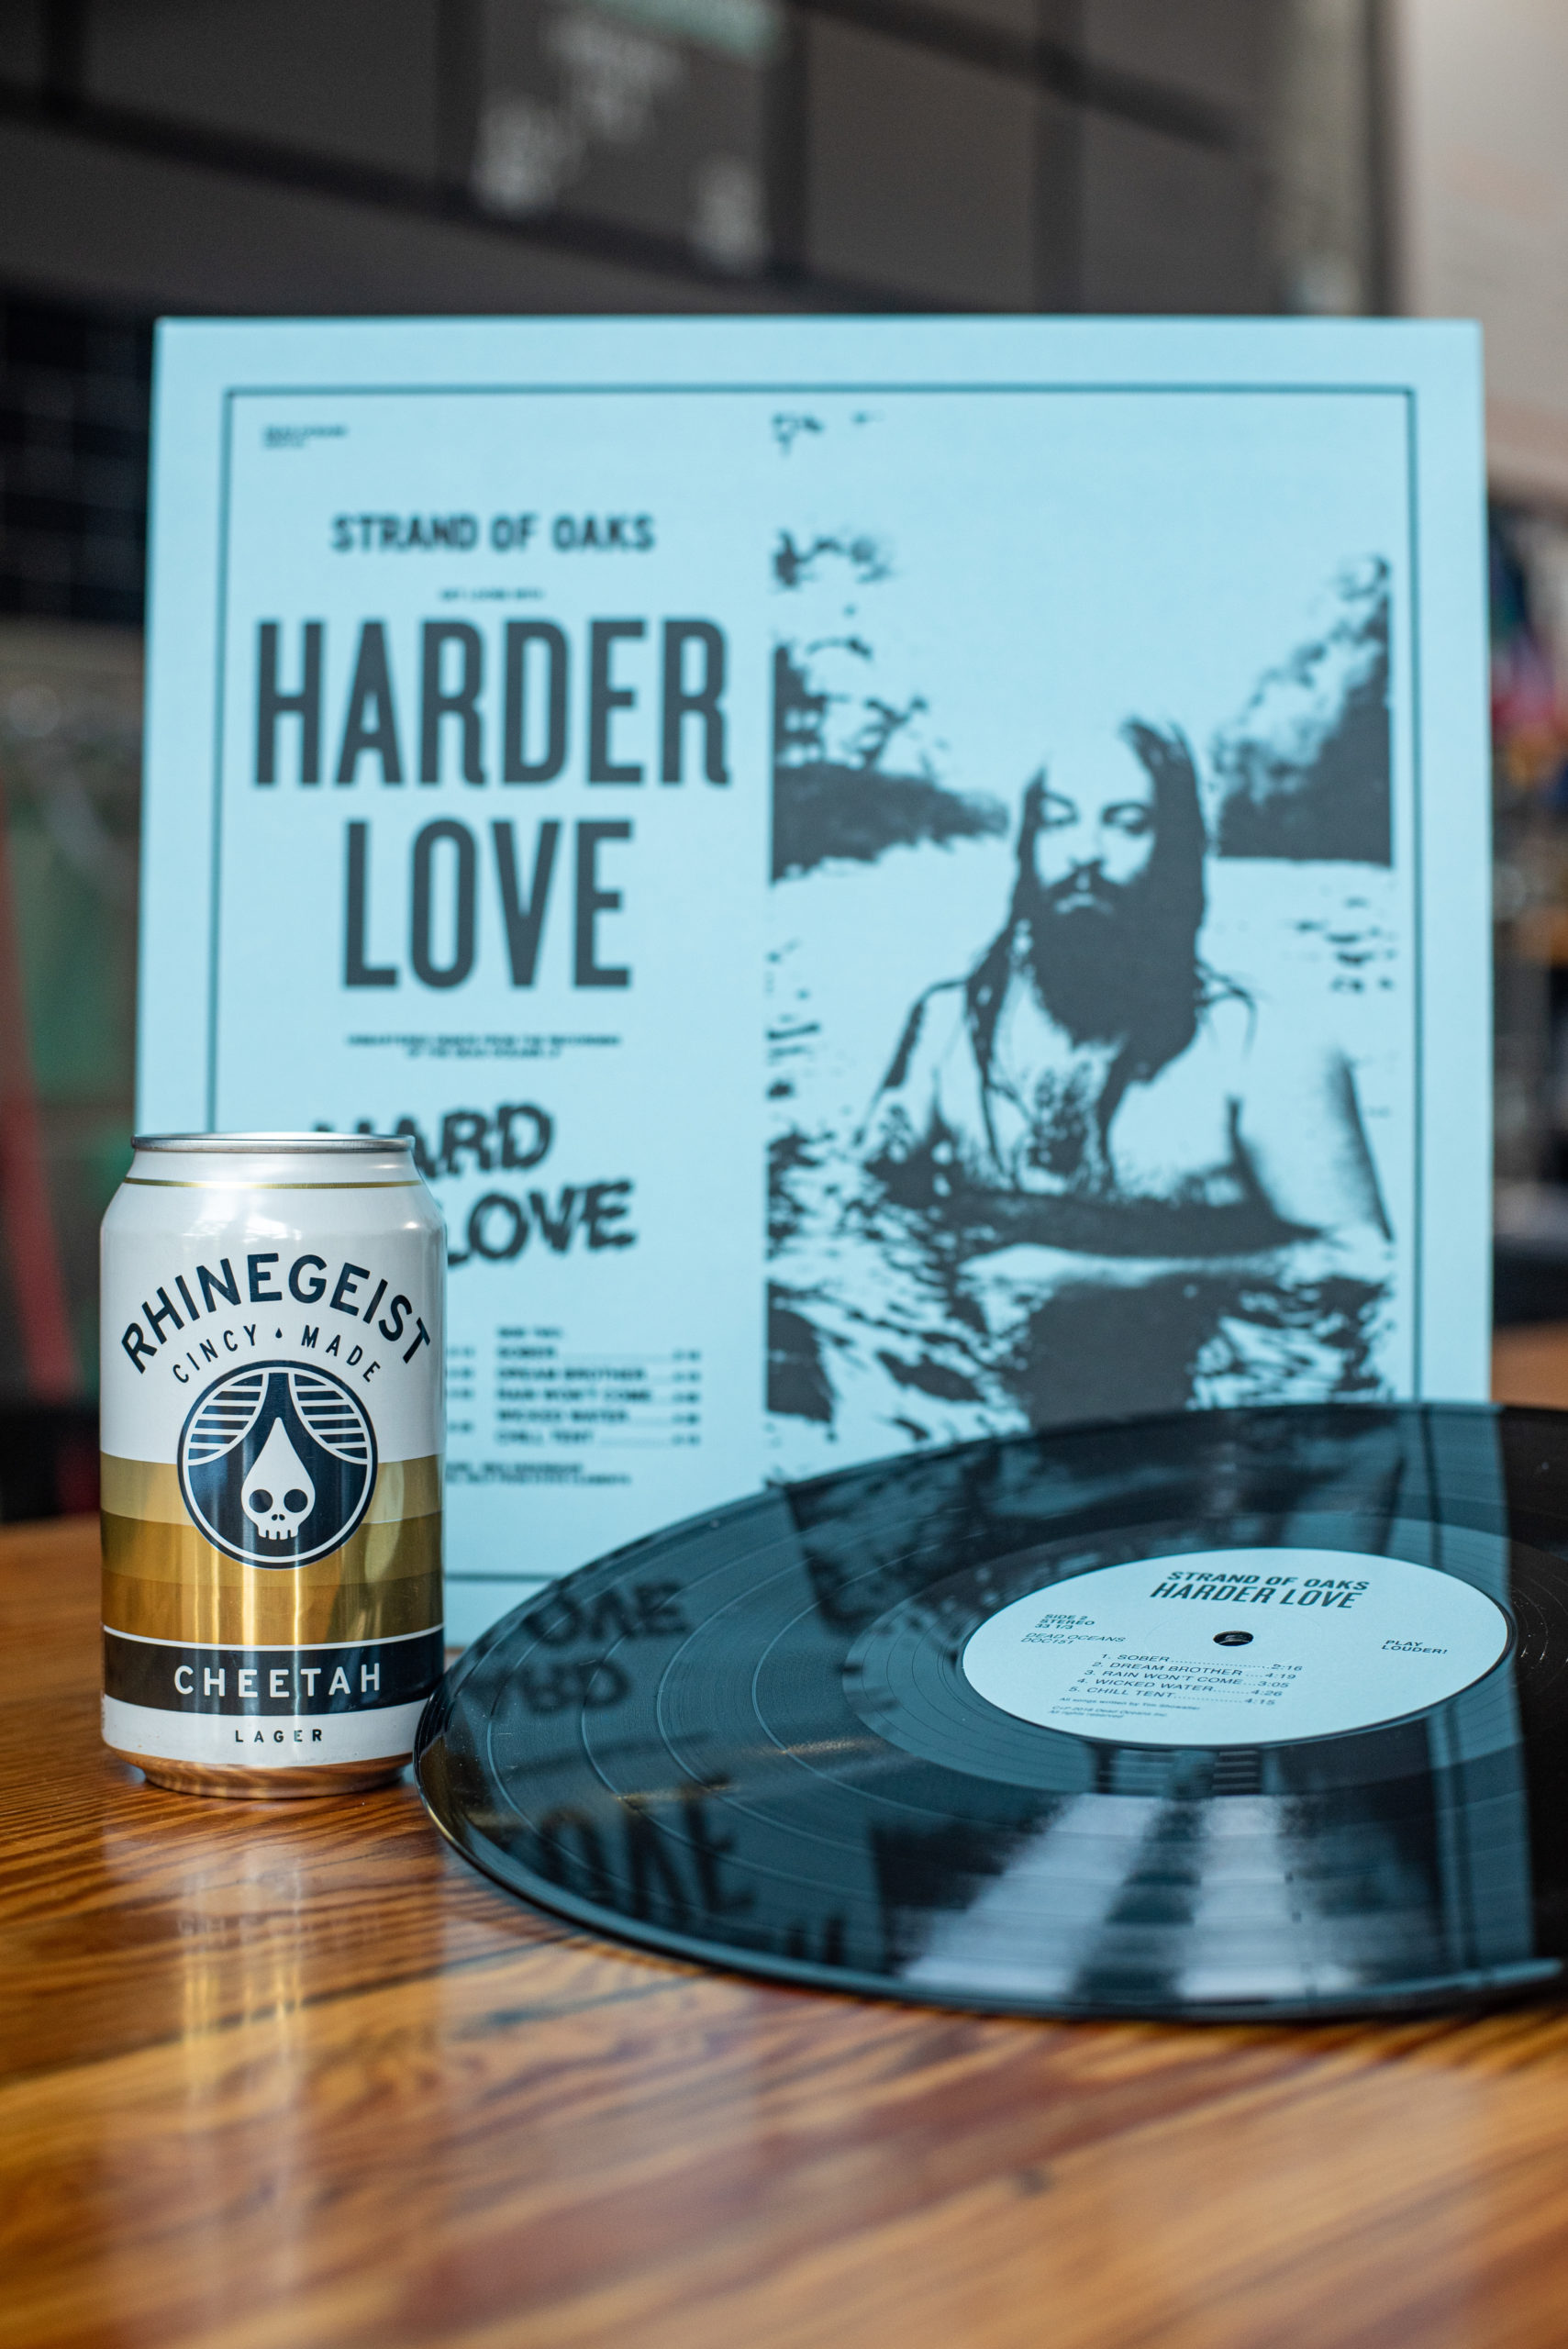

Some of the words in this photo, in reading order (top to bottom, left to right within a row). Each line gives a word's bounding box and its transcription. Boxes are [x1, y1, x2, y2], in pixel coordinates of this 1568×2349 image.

[331, 514, 478, 552] STRAND
[489, 514, 539, 552] OF
[551, 514, 656, 552] OAKS
[254, 618, 732, 788] HARDER
[341, 818, 634, 990] LOVE
[316, 1102, 554, 1178] ARD
[121, 1252, 431, 1375] RHINEGEIST
[172, 1324, 257, 1384] CINCY
[301, 1324, 382, 1383] MADE
[1167, 1571, 1261, 1584] STRAND
[1265, 1576, 1298, 1586] OF
[1303, 1578, 1371, 1590] OAKS
[1150, 1582, 1276, 1604] HARDER
[1279, 1589, 1362, 1609] LOVE
[1381, 1644, 1448, 1654] LOUDER!
[1109, 1662, 1164, 1671] DREAM
[1168, 1665, 1243, 1675] BROTHER
[1117, 1654, 1170, 1663] SOBER
[1271, 1664, 1303, 1672] 2:16
[174, 1663, 380, 1698] CHEETAH
[1095, 1678, 1156, 1688] WICKED
[1160, 1683, 1214, 1692] WATER
[1102, 1670, 1139, 1678] RAIN
[1144, 1674, 1194, 1682] WON'T
[1197, 1676, 1243, 1686] COME
[1087, 1687, 1129, 1696] CHILL
[1135, 1690, 1175, 1698] TENT
[235, 1729, 322, 1743] LAGER
